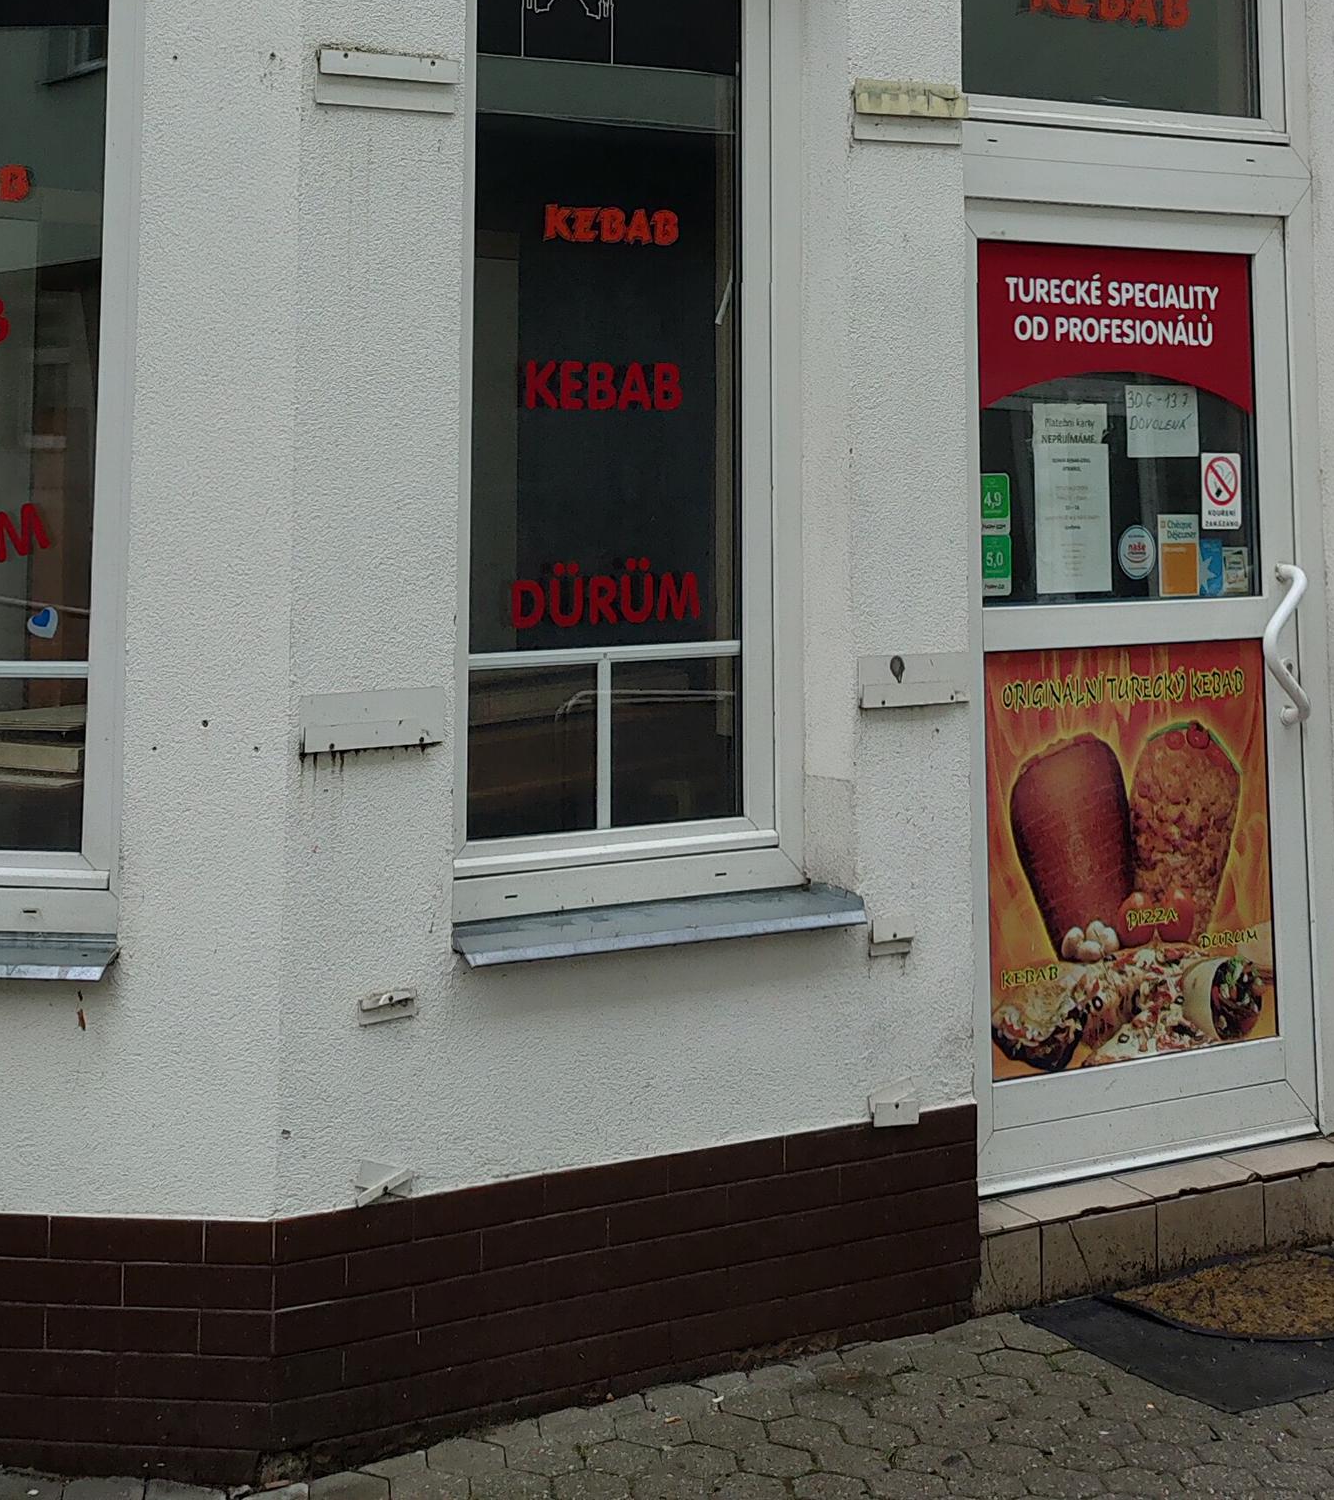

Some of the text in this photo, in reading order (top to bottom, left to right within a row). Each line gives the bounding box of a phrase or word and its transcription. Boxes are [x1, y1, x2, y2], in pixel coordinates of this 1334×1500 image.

[542, 203, 680, 246] KEBAB
[1005, 274, 1220, 311] TURECKÉ SPECIALITY
[1014, 313, 1214, 347] OD PROFESIONÁLŮ
[524, 360, 684, 411] KEBAB
[511, 556, 701, 630] DÜRÜM
[1002, 666, 1246, 714] ORIGINÁLNÍ TURECKÝ KEBAB
[1126, 907, 1179, 930] PIZZA
[1000, 966, 1060, 989] KEBAB
